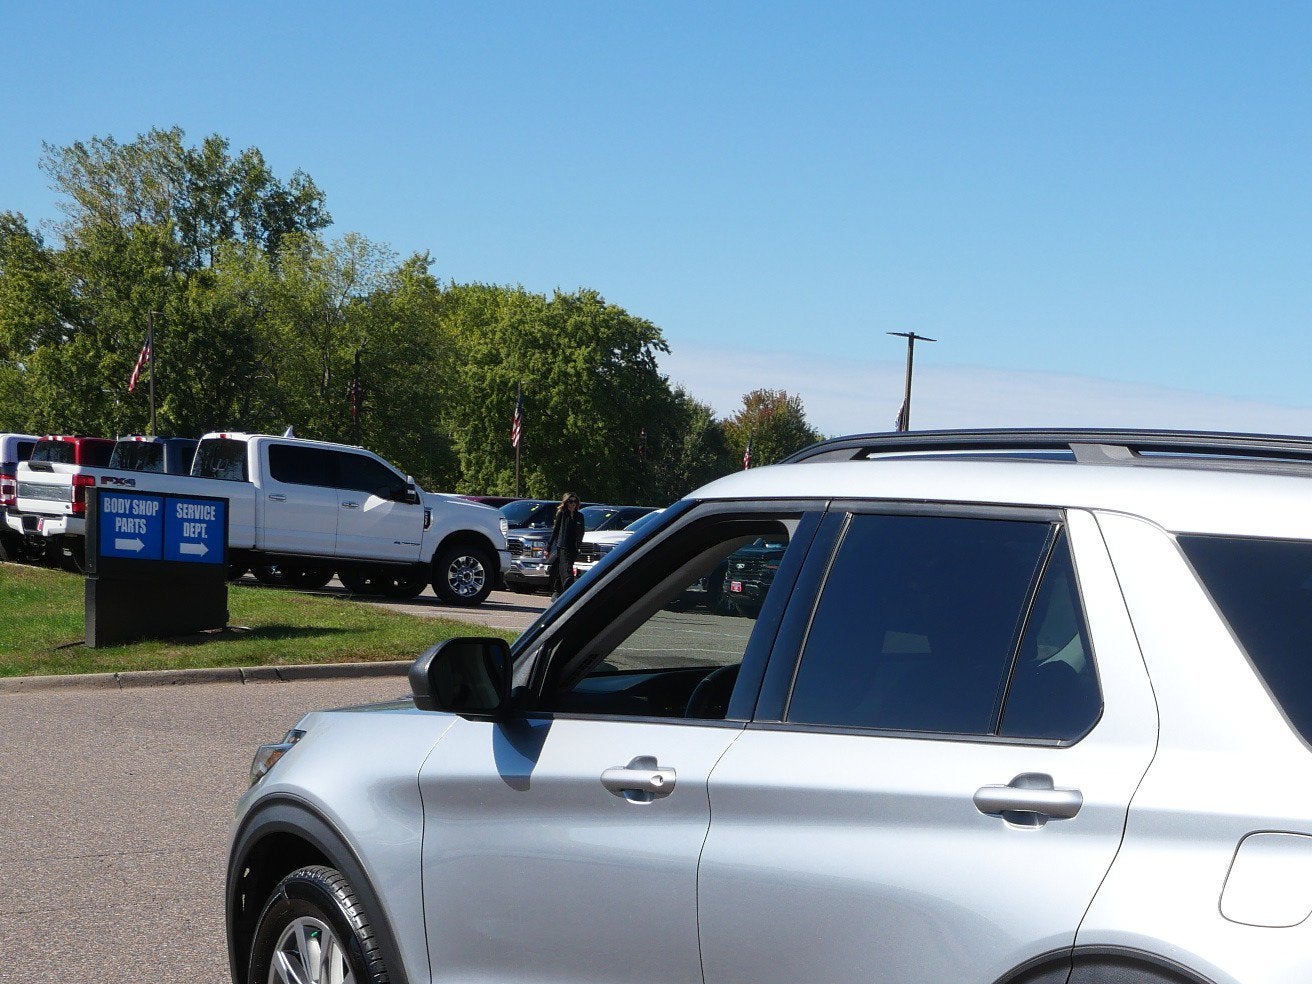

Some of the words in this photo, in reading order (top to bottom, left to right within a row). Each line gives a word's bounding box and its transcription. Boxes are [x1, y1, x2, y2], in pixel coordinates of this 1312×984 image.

[103, 497, 130, 513] BODY
[132, 499, 159, 516] SHOP
[176, 503, 216, 521] SERVICE
[115, 516, 147, 534] PARTS
[183, 522, 208, 539] DEPT.
